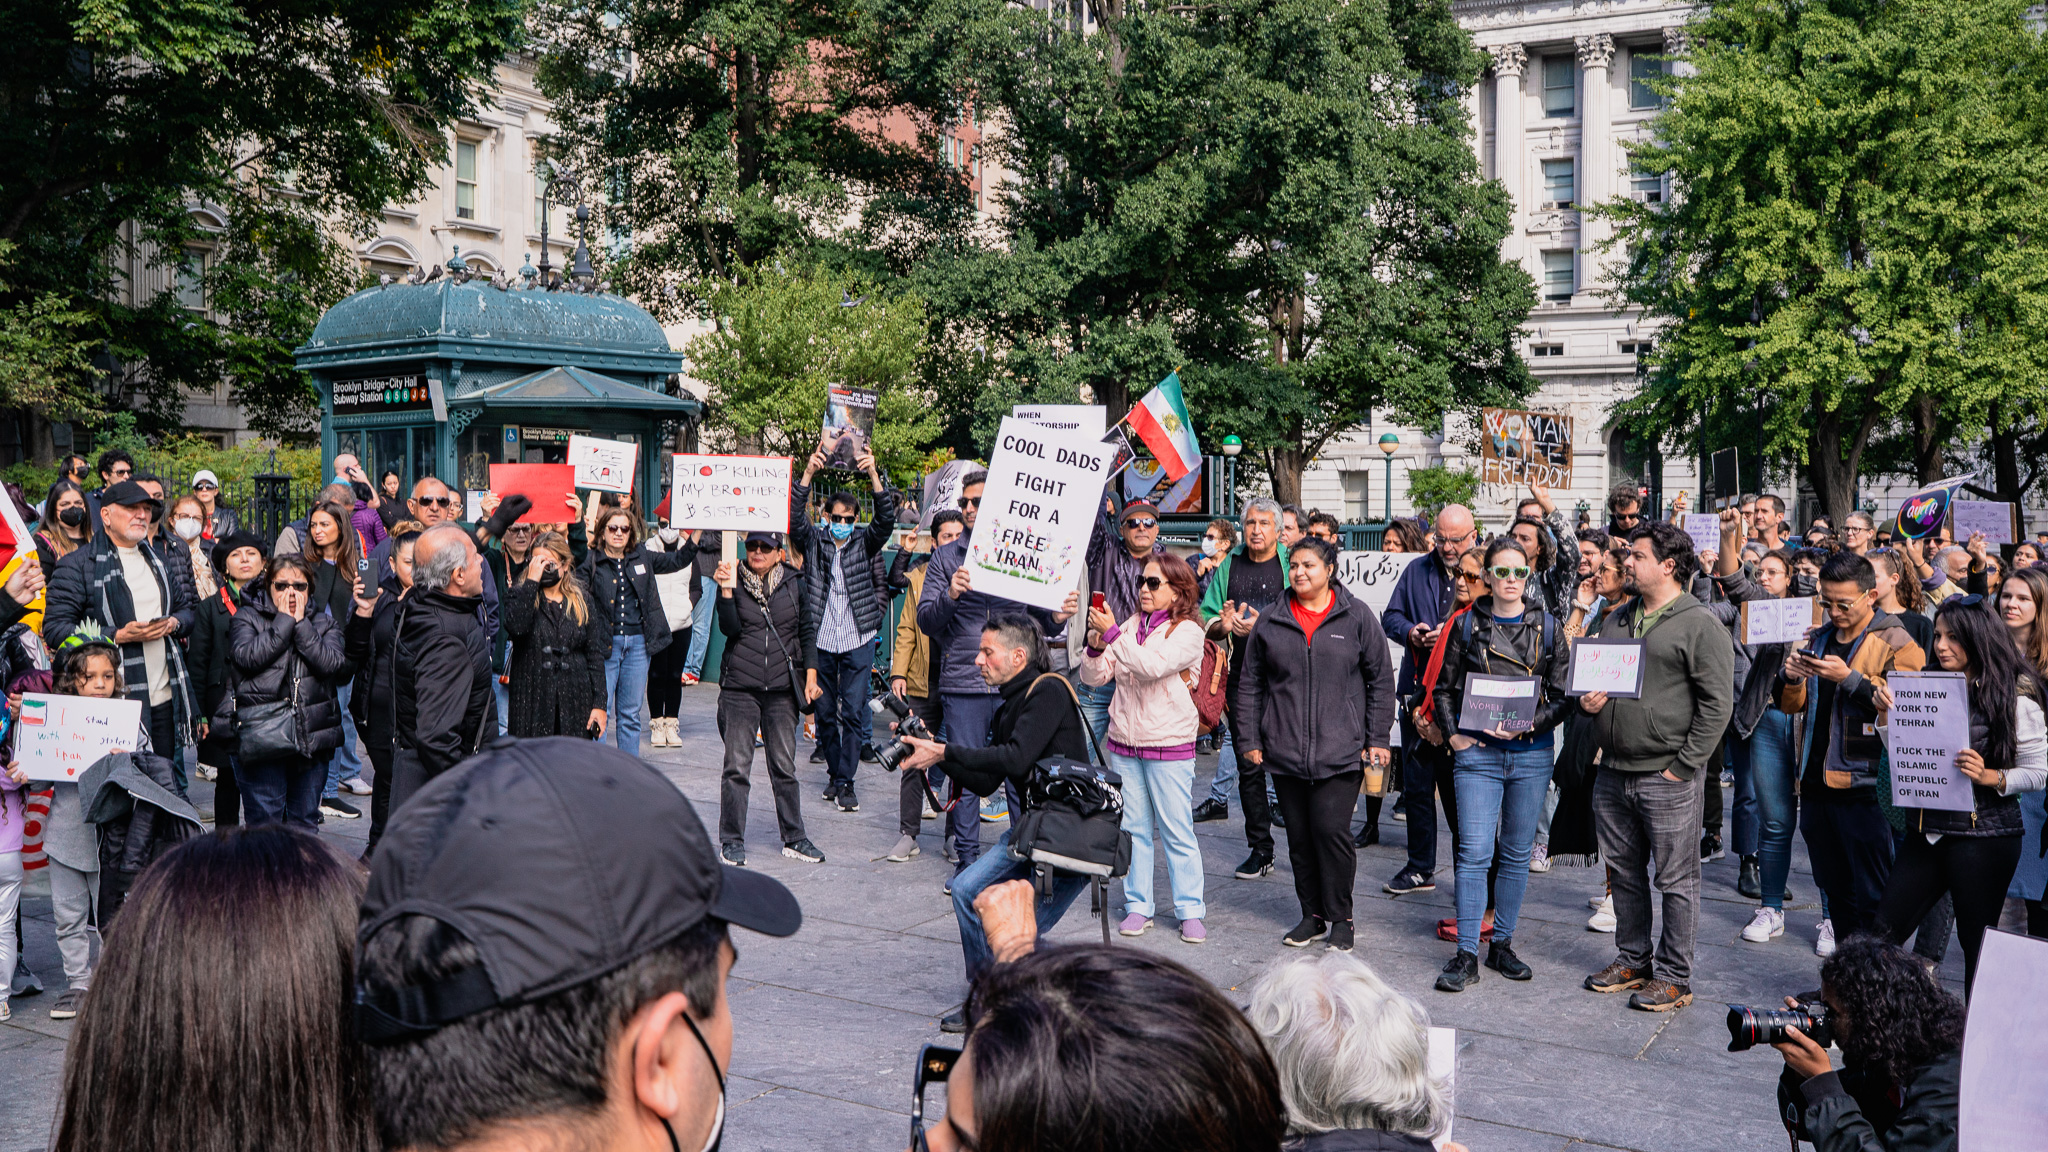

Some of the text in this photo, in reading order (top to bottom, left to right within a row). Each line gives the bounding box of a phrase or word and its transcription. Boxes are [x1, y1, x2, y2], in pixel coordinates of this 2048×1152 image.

[333, 381, 362, 394] Brooklyn
[404, 376, 418, 388] Hall
[333, 393, 359, 405] Subway
[359, 391, 384, 404] Station
[844, 399, 875, 410] Government
[1017, 411, 1041, 419] WHEN
[1485, 412, 1571, 445] WOMAN
[582, 445, 623, 464] FREE
[1003, 435, 1101, 472] COOL DADS
[1503, 436, 1562, 468] LIFE
[576, 465, 623, 484] IRAN
[676, 463, 788, 479] STOP KILLING
[1485, 457, 1571, 490] FREEDOM
[682, 482, 787, 498] MY BROTHERS
[1014, 472, 1066, 497] FIGHT
[702, 506, 771, 519] SISTERS
[1008, 500, 1060, 525] FOR A
[1906, 502, 1938, 519] QUEER
[1001, 529, 1047, 553] FREE
[996, 549, 1040, 571] IRAN
[1339, 553, 1399, 586] زندگی آزاد
[1895, 690, 1947, 699] FROM NEW
[1468, 699, 1504, 712] WOMEN
[1895, 704, 1938, 713] YORK TO
[60, 707, 109, 726] I stand
[1489, 710, 1518, 720] LIFE
[1502, 718, 1534, 730] FREEDOM
[1895, 718, 1935, 727] TEHRAN
[37, 730, 60, 741] with
[35, 748, 43, 757] in
[1896, 747, 1946, 757] FUCK THE
[1897, 761, 1938, 771] ISLAMIC
[1897, 775, 1948, 785] REPUBLIC
[1898, 788, 1940, 799] OF IRAN
[1410, 873, 1424, 886] N
